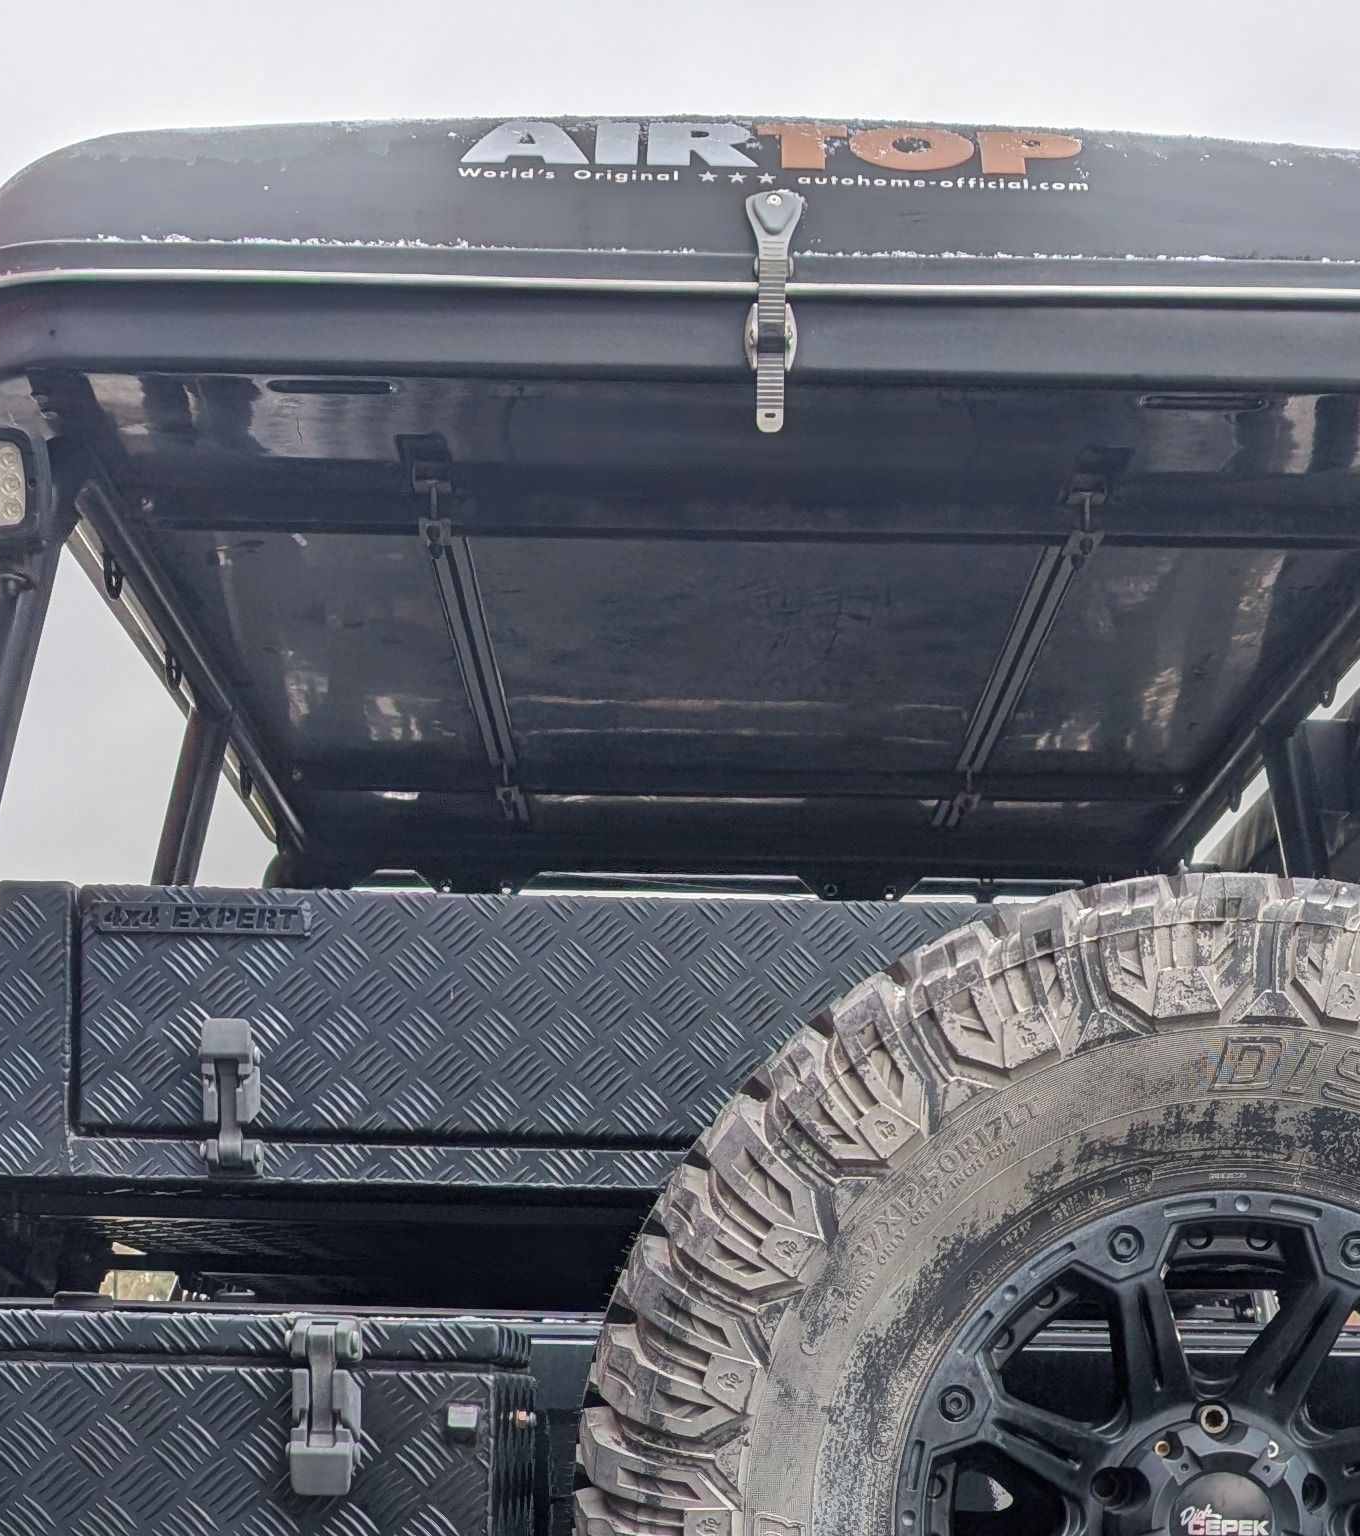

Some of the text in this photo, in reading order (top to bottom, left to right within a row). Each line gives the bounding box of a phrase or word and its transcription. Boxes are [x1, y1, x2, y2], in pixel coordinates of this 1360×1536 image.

[459, 121, 1082, 175] AIRTOP
[457, 166, 680, 184] World's Original
[797, 174, 1089, 191] autohome-official.com
[103, 905, 299, 931] 4x4 EXPERT
[1187, 1519, 1271, 1536] CEPEK
